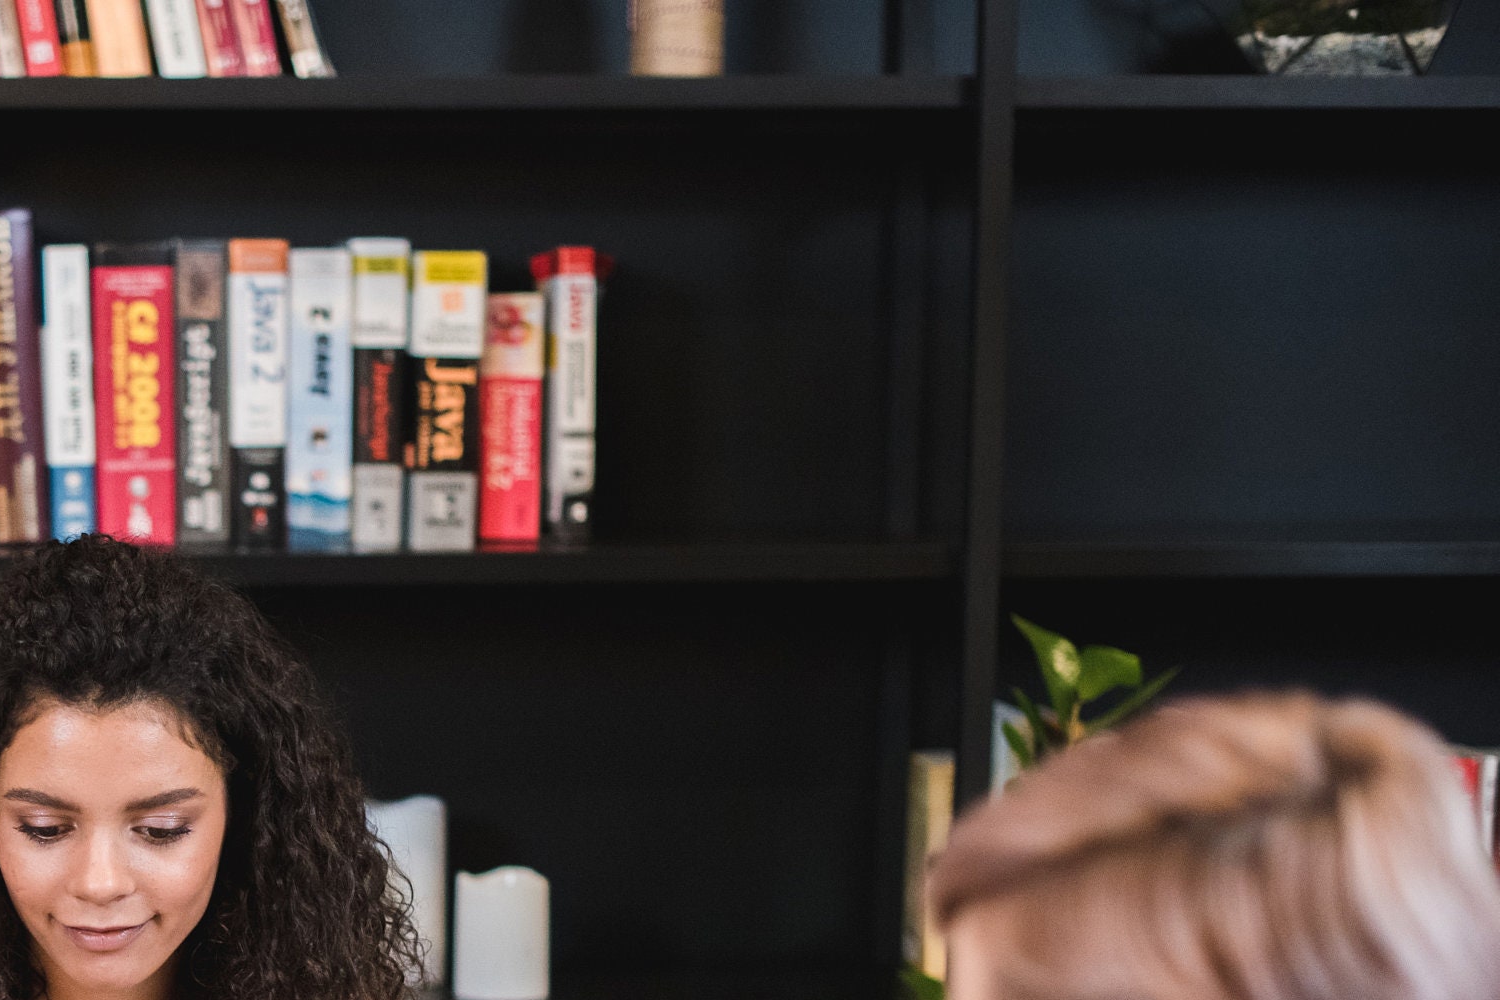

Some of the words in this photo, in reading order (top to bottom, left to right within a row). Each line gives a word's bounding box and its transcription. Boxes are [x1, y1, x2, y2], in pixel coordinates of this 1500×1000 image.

[247, 280, 284, 354] Java
[311, 307, 330, 321] 2
[569, 283, 589, 333] Java
[251, 365, 285, 383] 2
[309, 334, 330, 397] Java
[129, 352, 160, 448] 2008
[182, 324, 216, 486] JavaScript
[426, 359, 476, 462] Java
